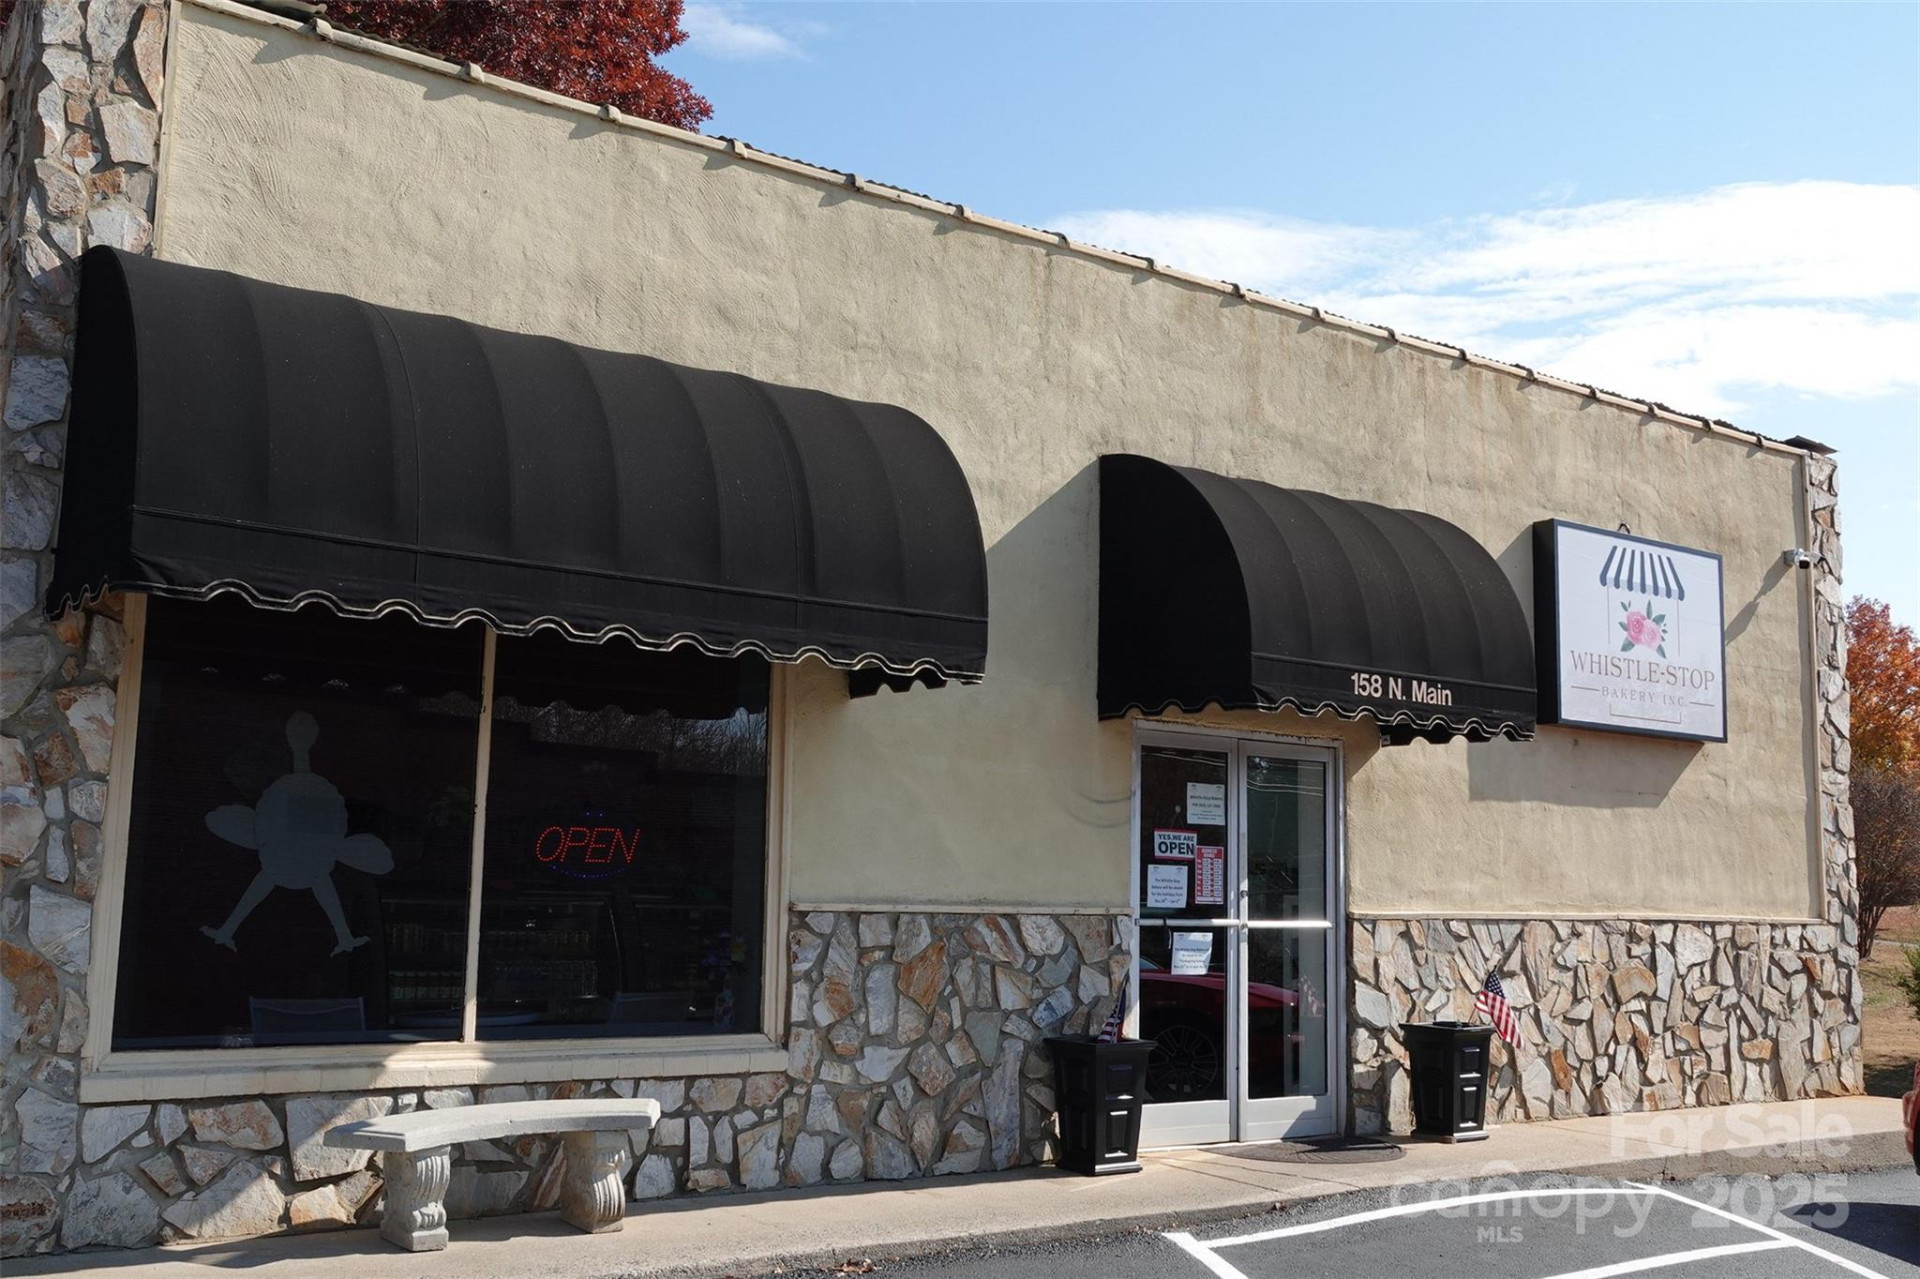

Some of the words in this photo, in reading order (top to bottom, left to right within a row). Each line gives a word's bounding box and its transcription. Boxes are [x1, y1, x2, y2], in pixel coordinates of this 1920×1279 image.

[1570, 650, 1715, 690] WHISTLE-STOP
[1351, 672, 1383, 698] 158
[1389, 677, 1406, 700] N.
[1412, 680, 1452, 706] Main
[1602, 685, 1655, 703] BAKERY
[1663, 694, 1688, 707] INC.
[536, 825, 641, 864] OPEN
[1158, 841, 1195, 856] OPEN
[1182, 834, 1195, 842] ARE
